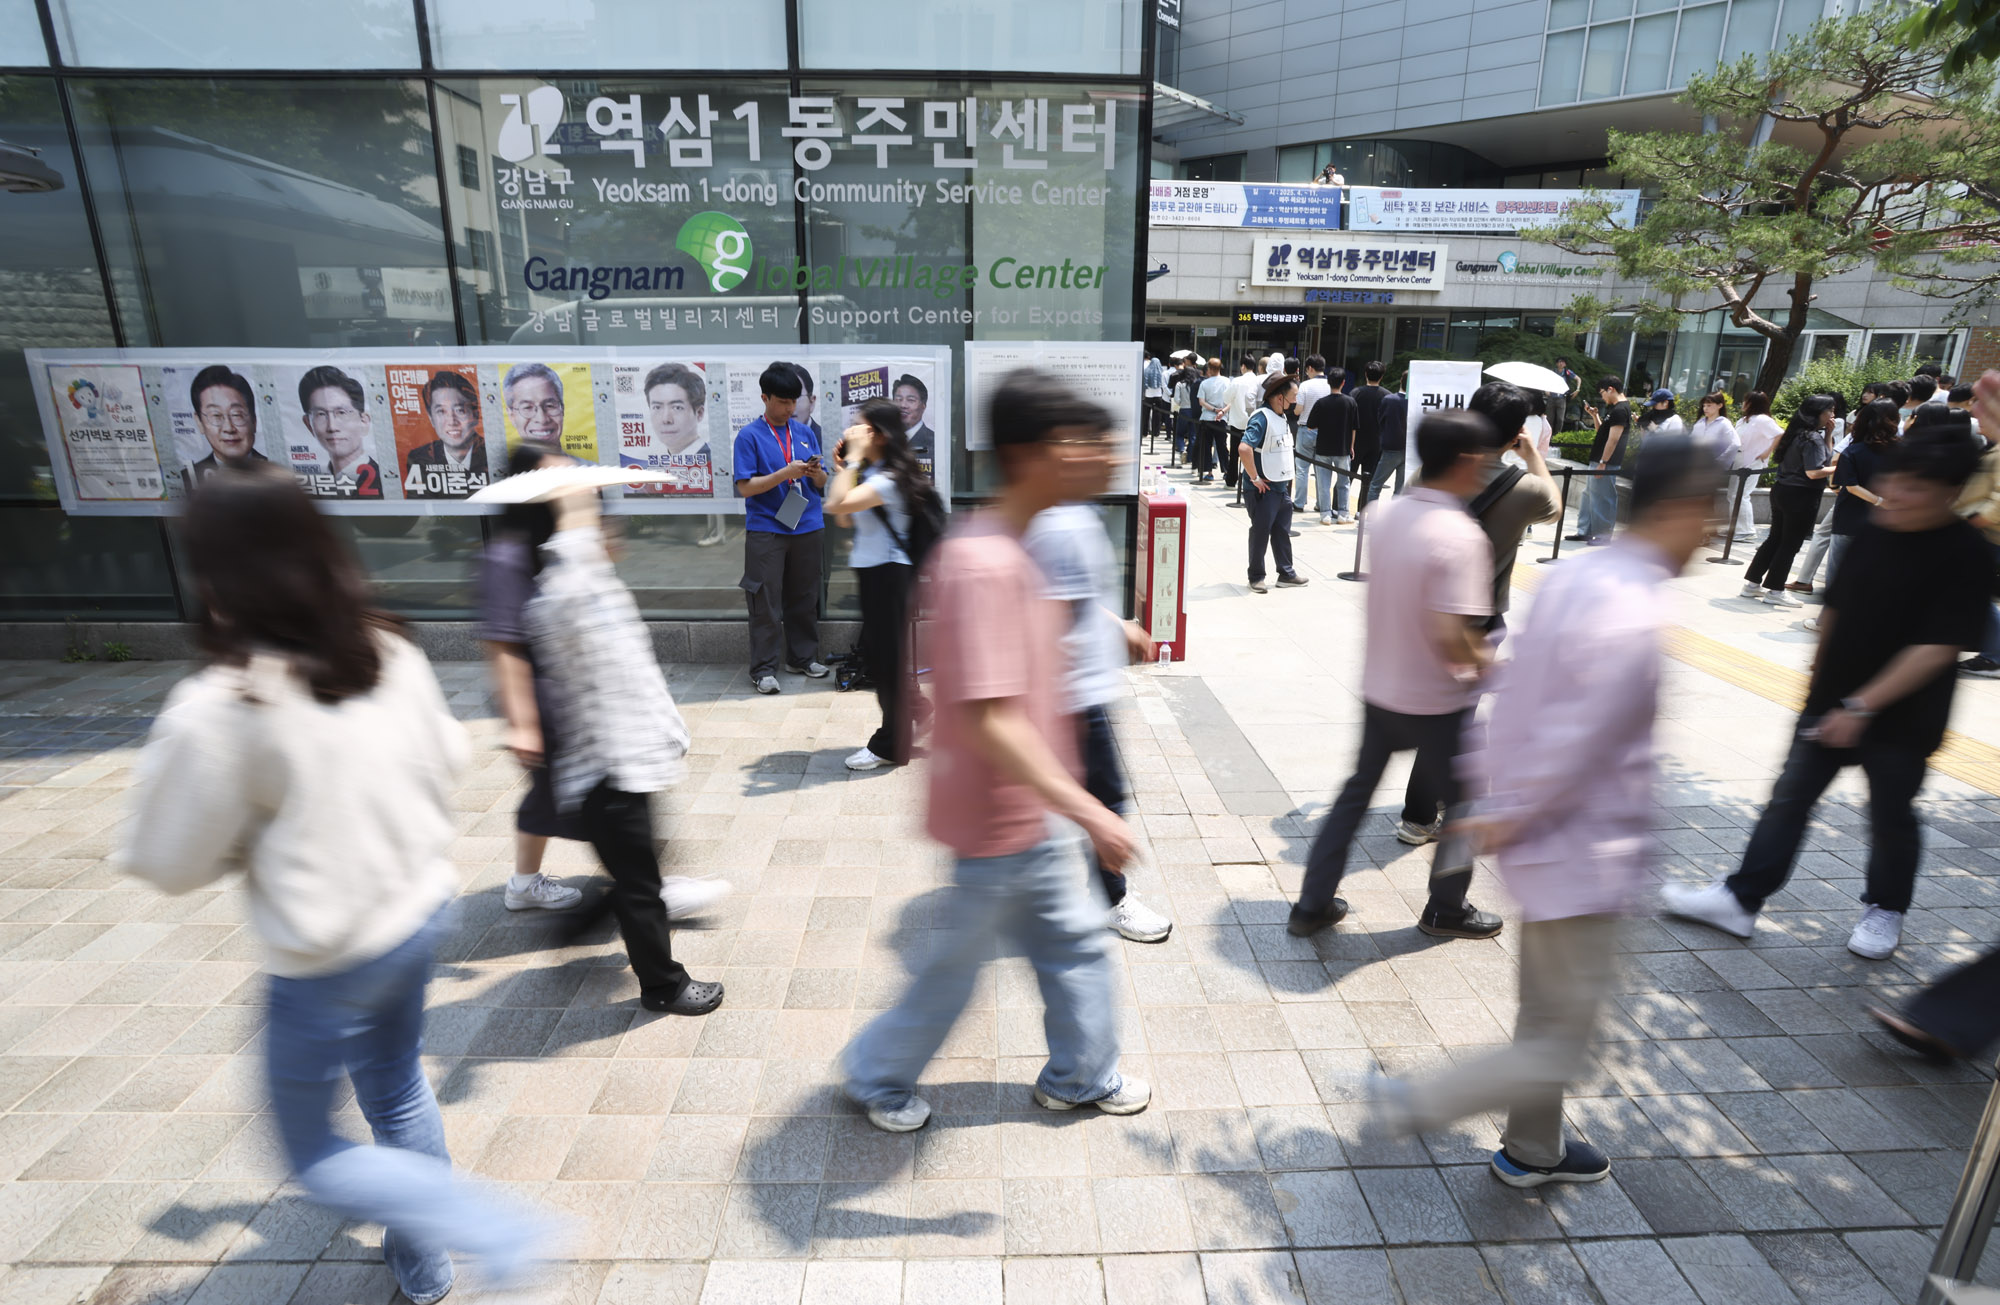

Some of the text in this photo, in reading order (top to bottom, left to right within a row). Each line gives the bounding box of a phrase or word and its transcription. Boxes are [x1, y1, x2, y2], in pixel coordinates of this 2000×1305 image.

[1157, 9, 1179, 28] Complex
[586, 94, 1116, 170] 역삼1동주민센터
[497, 168, 574, 195] 강남구
[592, 177, 1111, 207] Yeoksam 1-dong Community Service Center
[1174, 187, 1191, 198] 거점
[1204, 202, 1238, 214] 드립니다
[1383, 201, 1406, 213] 세탁
[1407, 201, 1418, 213] 및
[1420, 201, 1431, 213] 짐
[1434, 201, 1456, 213] 보관
[1458, 201, 1490, 213] 서비스
[1297, 246, 1437, 272] 역삼1동주민센터
[1267, 268, 1291, 278] 강남구
[1455, 261, 1498, 274] Gangnam
[1540, 263, 1573, 278] Village
[523, 256, 685, 300] Gangnam
[853, 256, 979, 299] Village
[989, 257, 1110, 290] Center
[1296, 272, 1432, 284] Yeoksam 1-dong Community Service Center
[812, 307, 900, 328] Support
[908, 307, 980, 325] Center
[991, 307, 1019, 325] for
[1028, 307, 1103, 328] Expats
[1238, 313, 1305, 323] 365 무인민원발급창구
[391, 385, 418, 400] 여는
[847, 384, 883, 403] 후정치!
[394, 399, 421, 415] 선택
[69, 429, 148, 442] 선거벽보 주의문
[621, 422, 646, 435] 정치
[623, 435, 651, 448] 교체!
[356, 464, 379, 496] 2
[404, 463, 488, 495] 4 이준석
